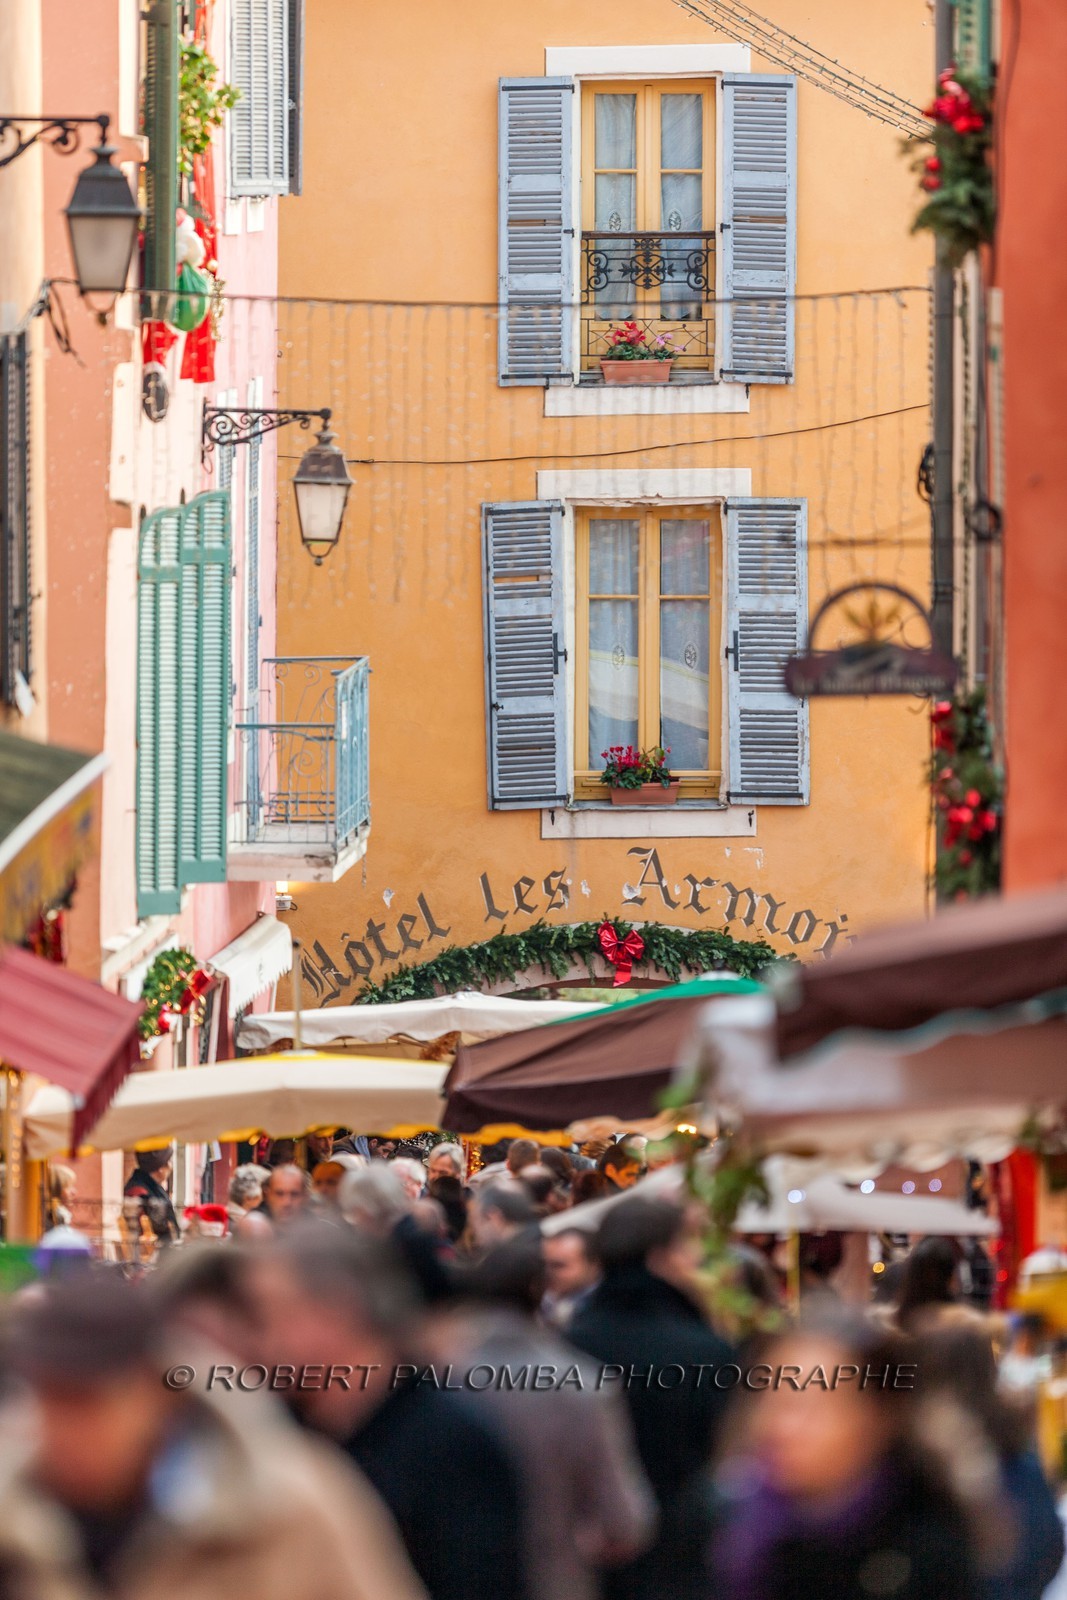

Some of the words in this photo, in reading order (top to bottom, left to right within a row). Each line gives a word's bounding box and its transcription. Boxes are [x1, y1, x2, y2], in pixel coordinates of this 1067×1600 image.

[301, 892, 451, 1008] Hôtel
[479, 866, 571, 922] les
[621, 846, 858, 960] Armoi
